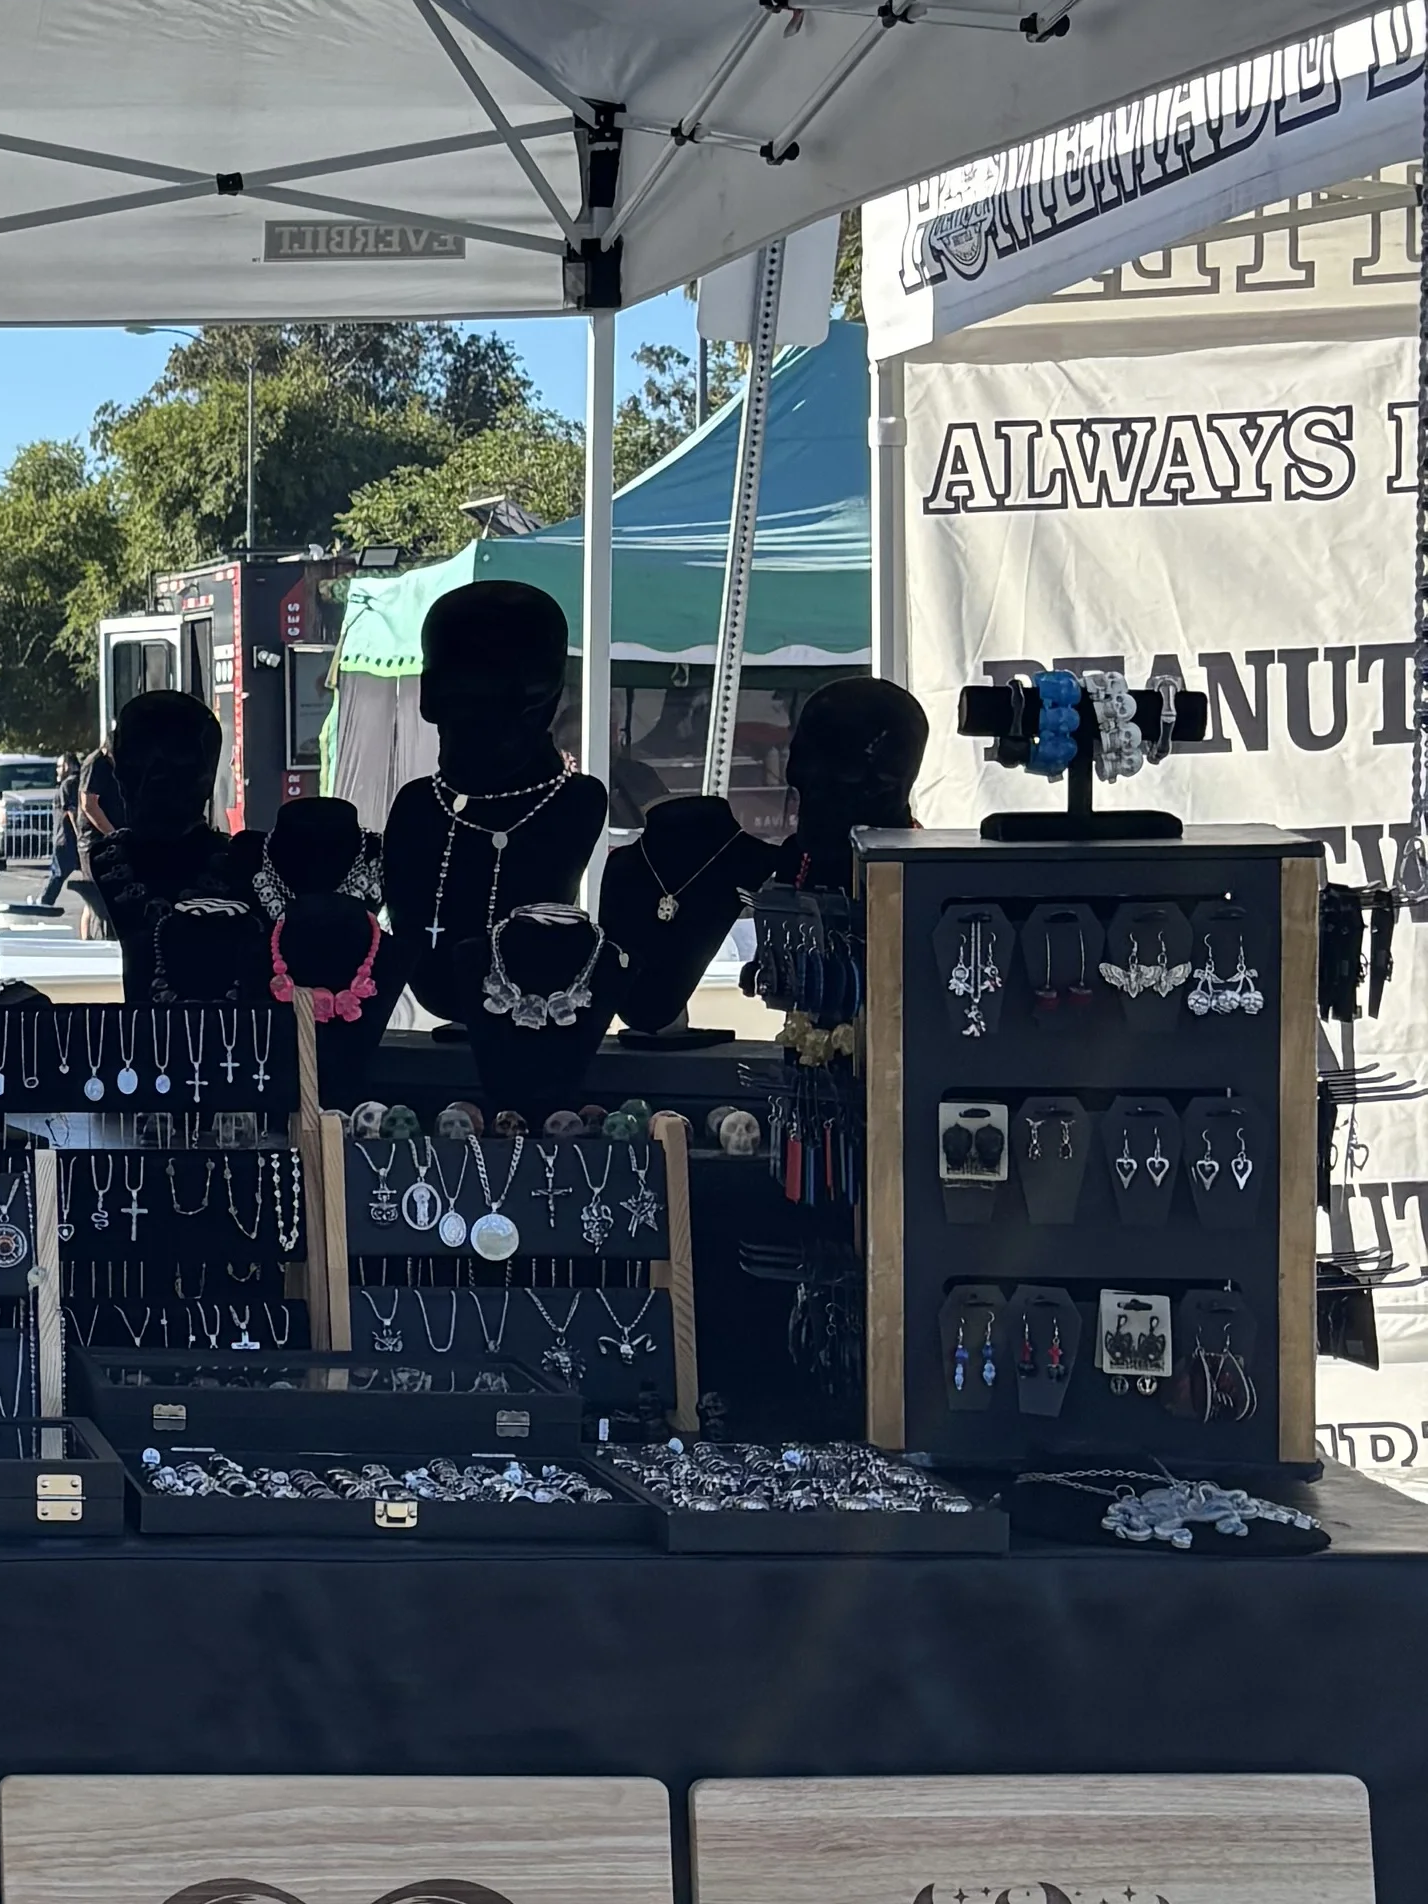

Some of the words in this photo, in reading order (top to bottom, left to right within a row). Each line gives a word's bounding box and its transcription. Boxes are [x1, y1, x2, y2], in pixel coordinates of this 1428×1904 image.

[900, 29, 1341, 295] HMEMADE
[923, 405, 1356, 515] ALWAYS
[983, 642, 1419, 762] ANUT
